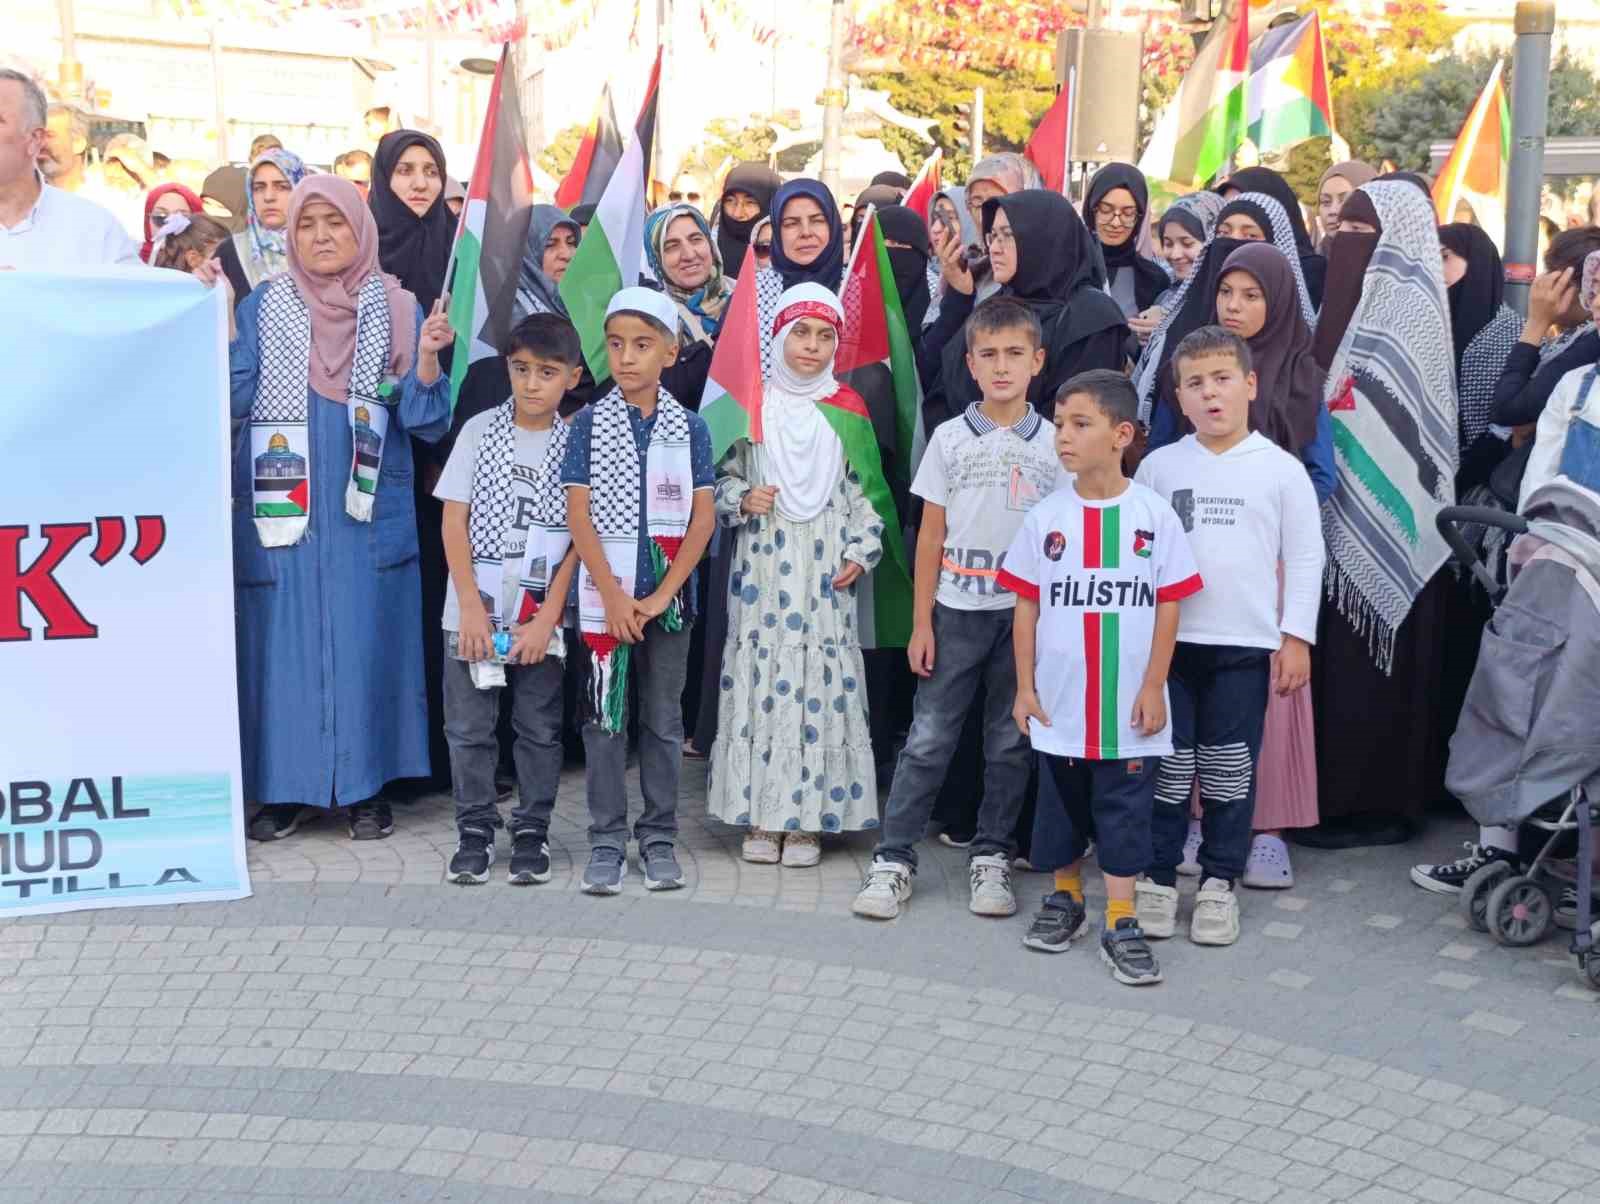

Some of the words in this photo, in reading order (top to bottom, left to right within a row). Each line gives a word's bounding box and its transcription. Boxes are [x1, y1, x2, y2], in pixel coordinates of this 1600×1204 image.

[1050, 574, 1155, 608] FİLİSTİN
[0, 775, 151, 826] BAL
[0, 828, 103, 876] UD
